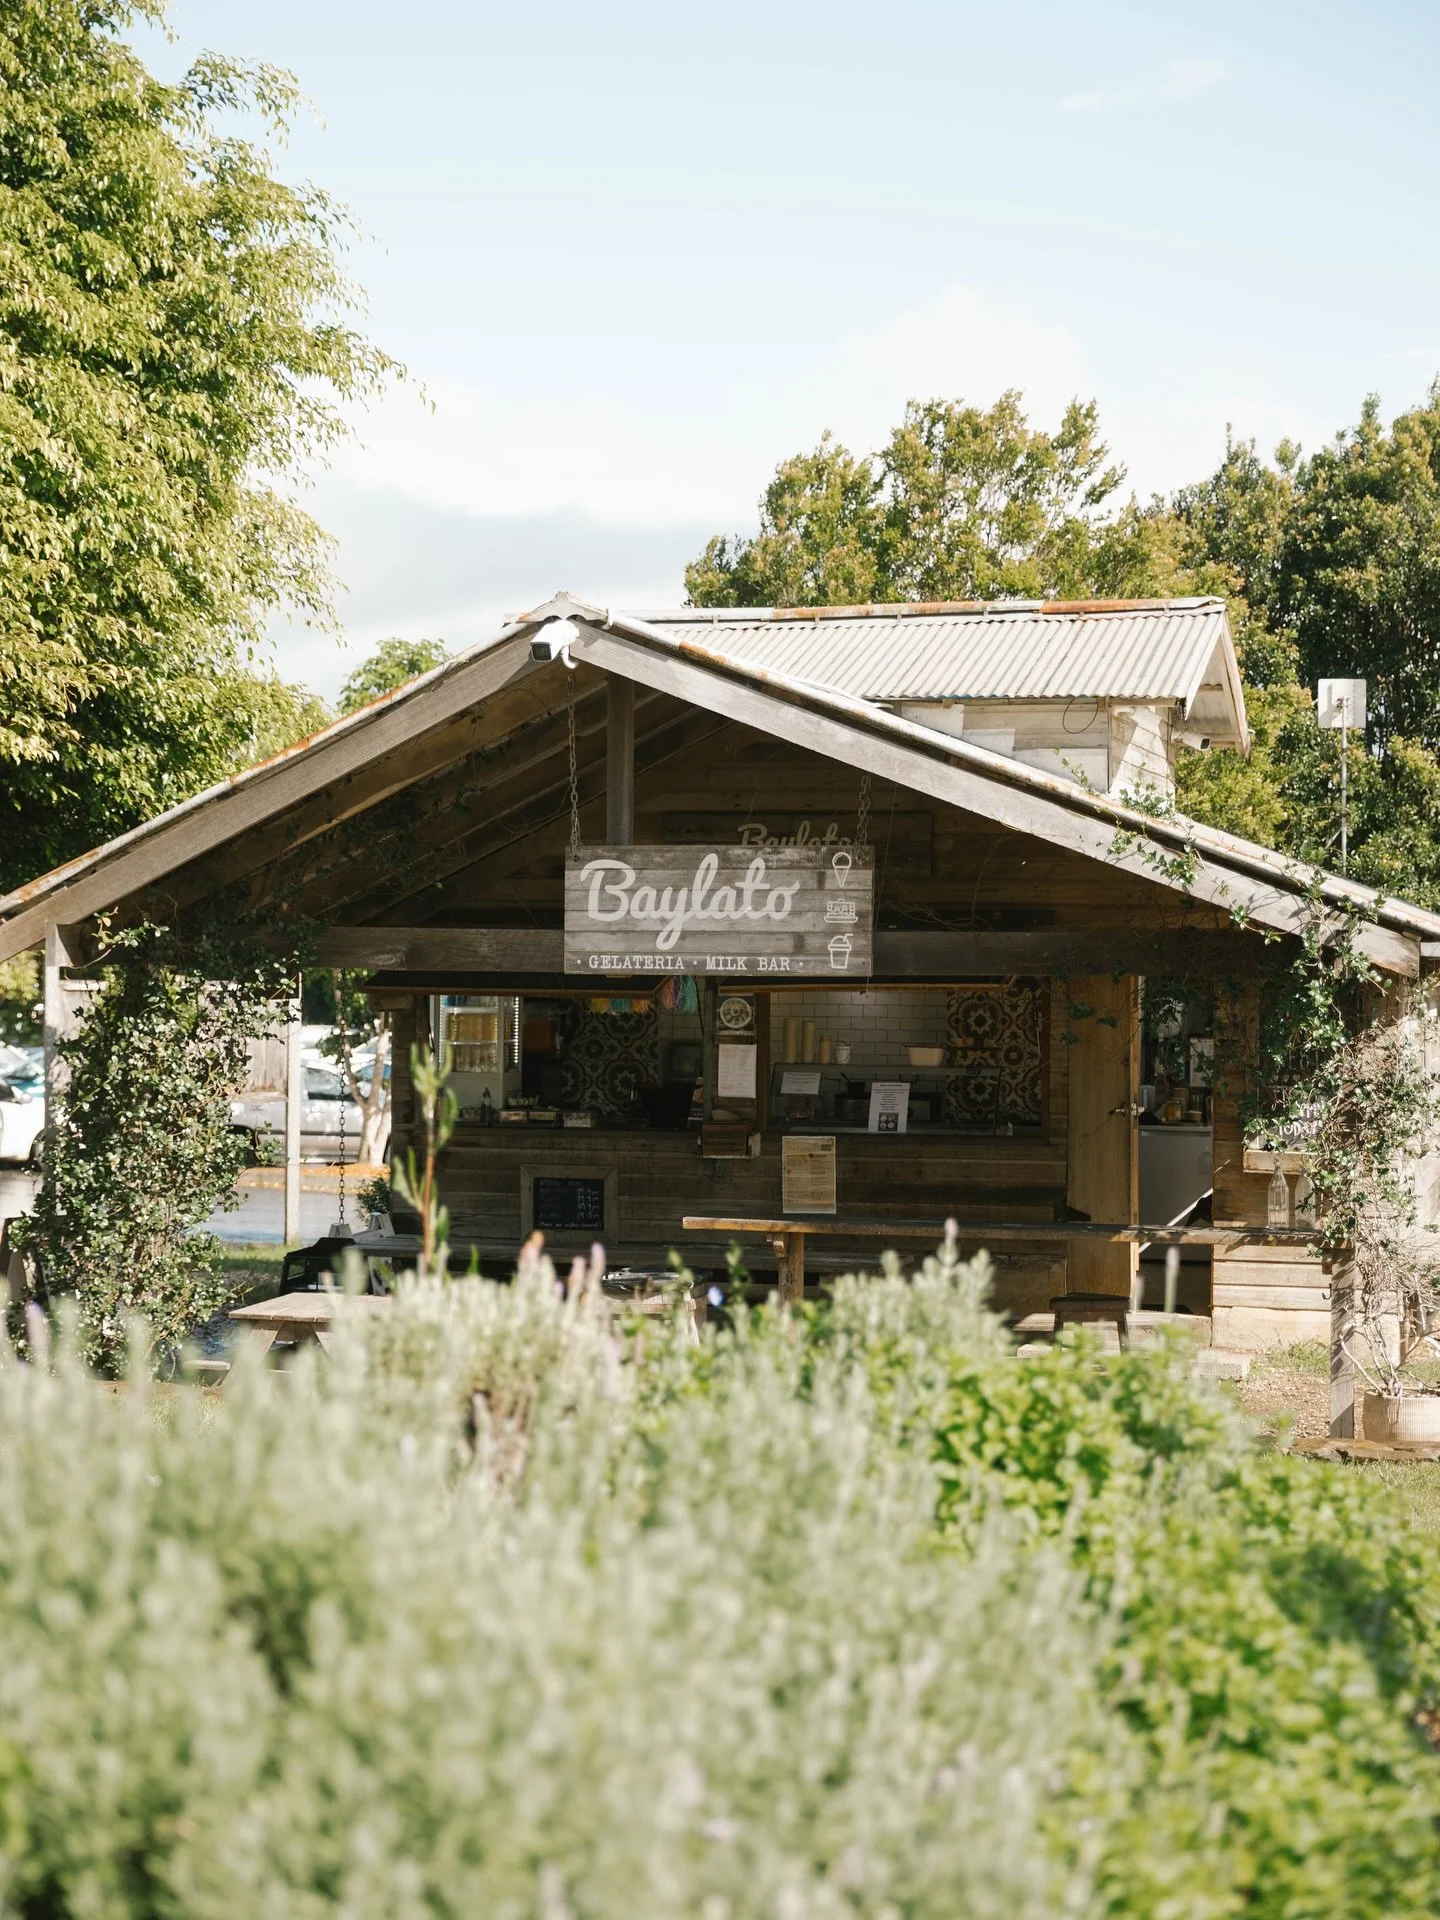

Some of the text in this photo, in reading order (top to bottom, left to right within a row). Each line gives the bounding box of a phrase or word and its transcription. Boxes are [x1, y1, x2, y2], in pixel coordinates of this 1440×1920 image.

[580, 853, 800, 950] Baylato
[588, 955, 791, 971] GELATERIA MILK BAR
